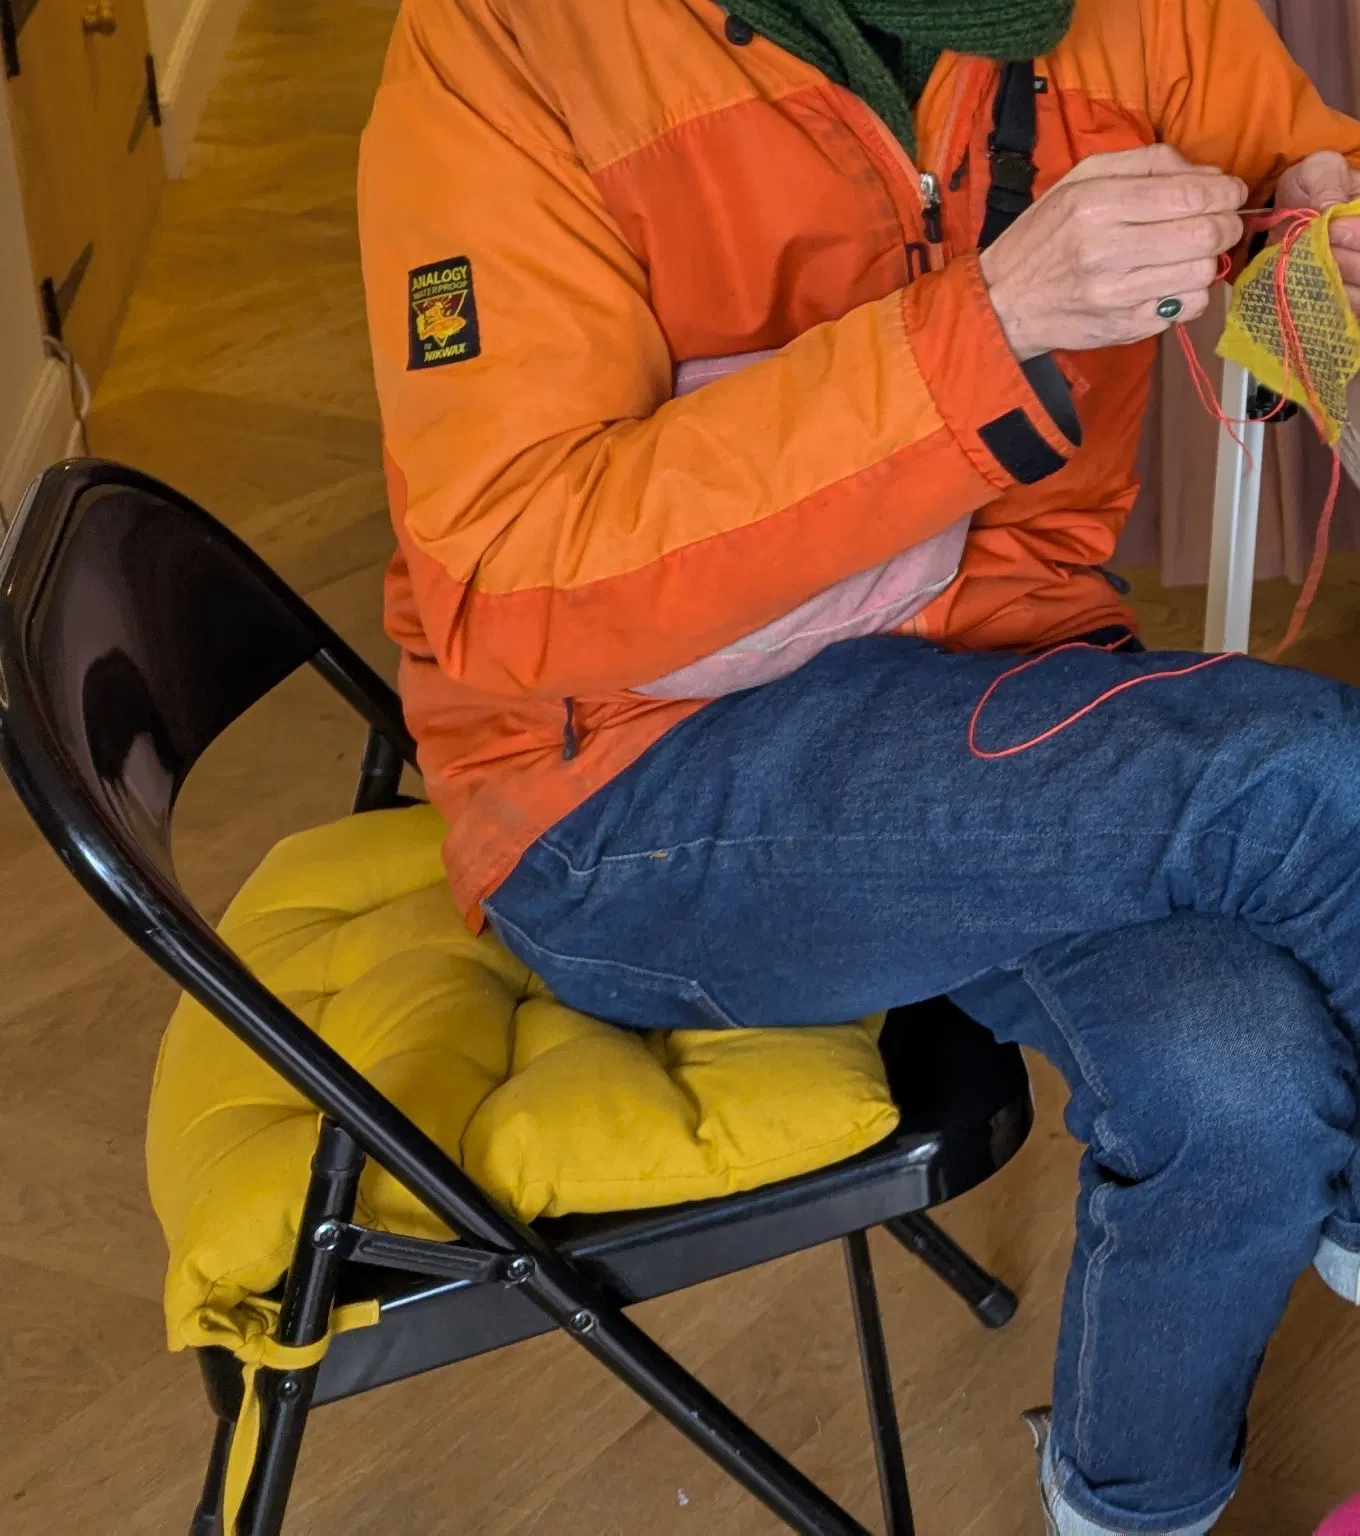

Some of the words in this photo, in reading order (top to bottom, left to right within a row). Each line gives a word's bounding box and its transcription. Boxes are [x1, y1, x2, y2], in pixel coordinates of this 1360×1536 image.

[412, 265, 467, 292] ANALOGY
[413, 280, 468, 300] WATERPROOF
[424, 343, 465, 362] NIKWAX
